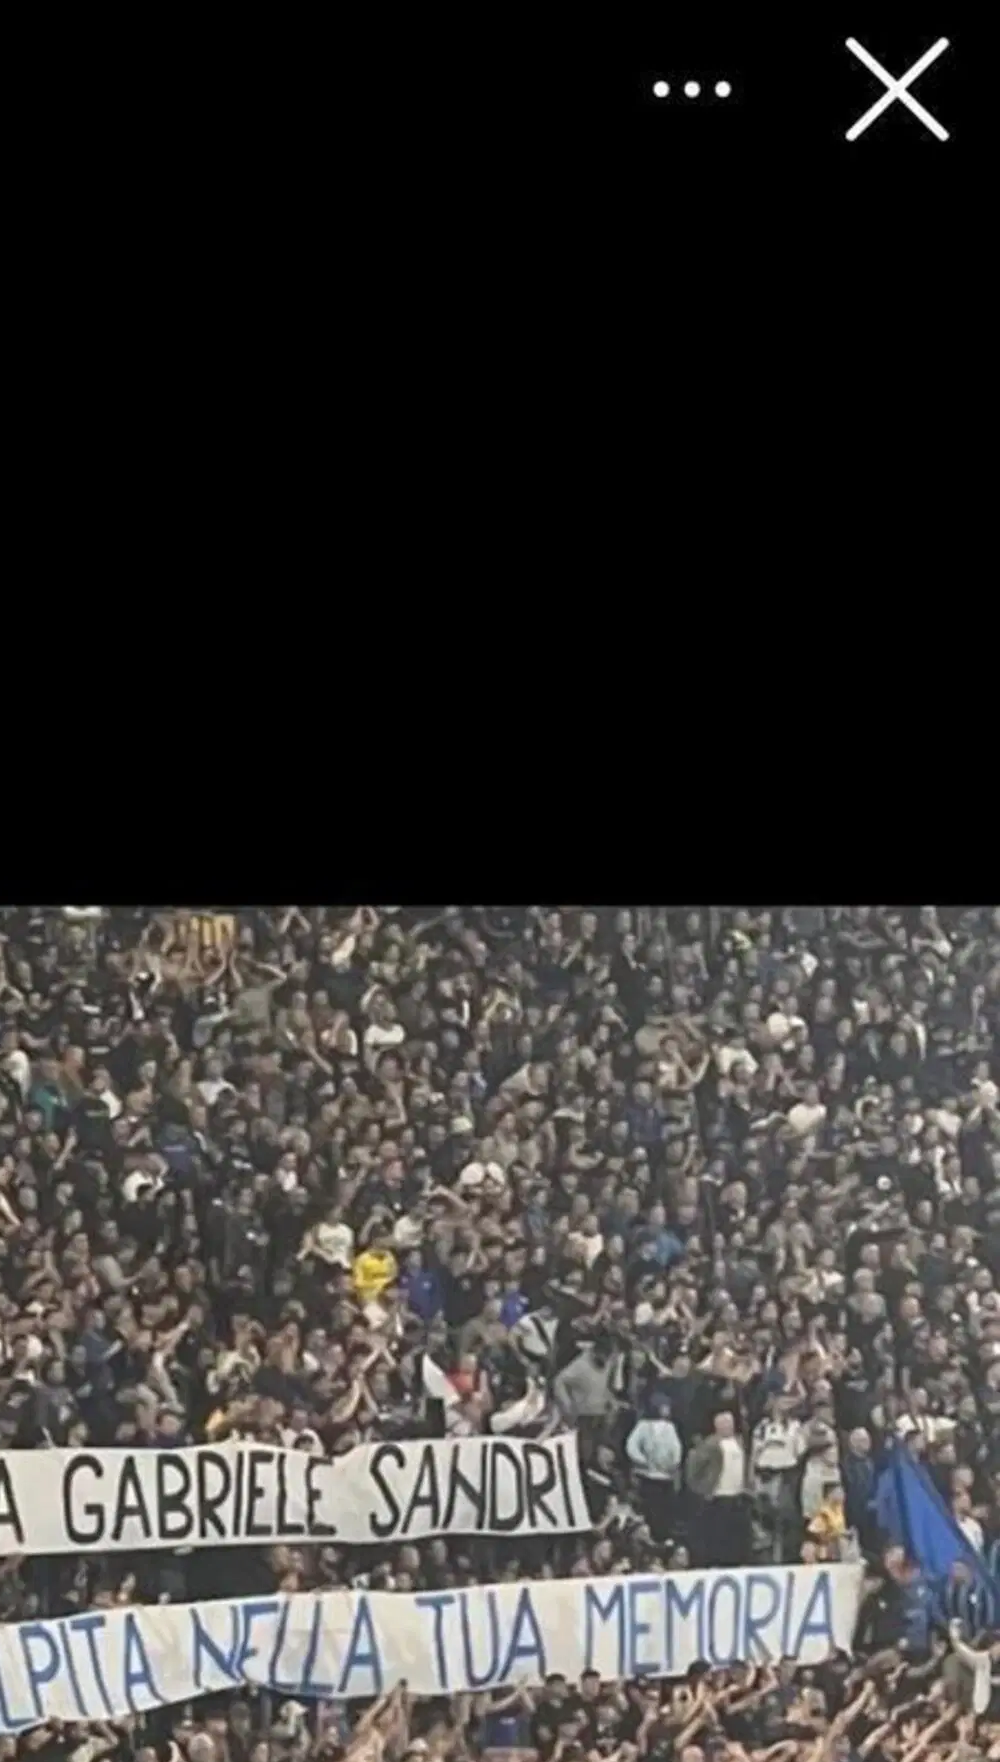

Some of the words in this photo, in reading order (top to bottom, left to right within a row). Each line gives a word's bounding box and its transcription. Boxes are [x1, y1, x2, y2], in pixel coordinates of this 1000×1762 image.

[63, 1449, 338, 1544] GABRIELE
[370, 1441, 574, 1533] SANDRI
[190, 1600, 384, 1698] NELLA
[416, 1586, 546, 1689] TUA
[586, 1570, 835, 1677] MEMORIA
